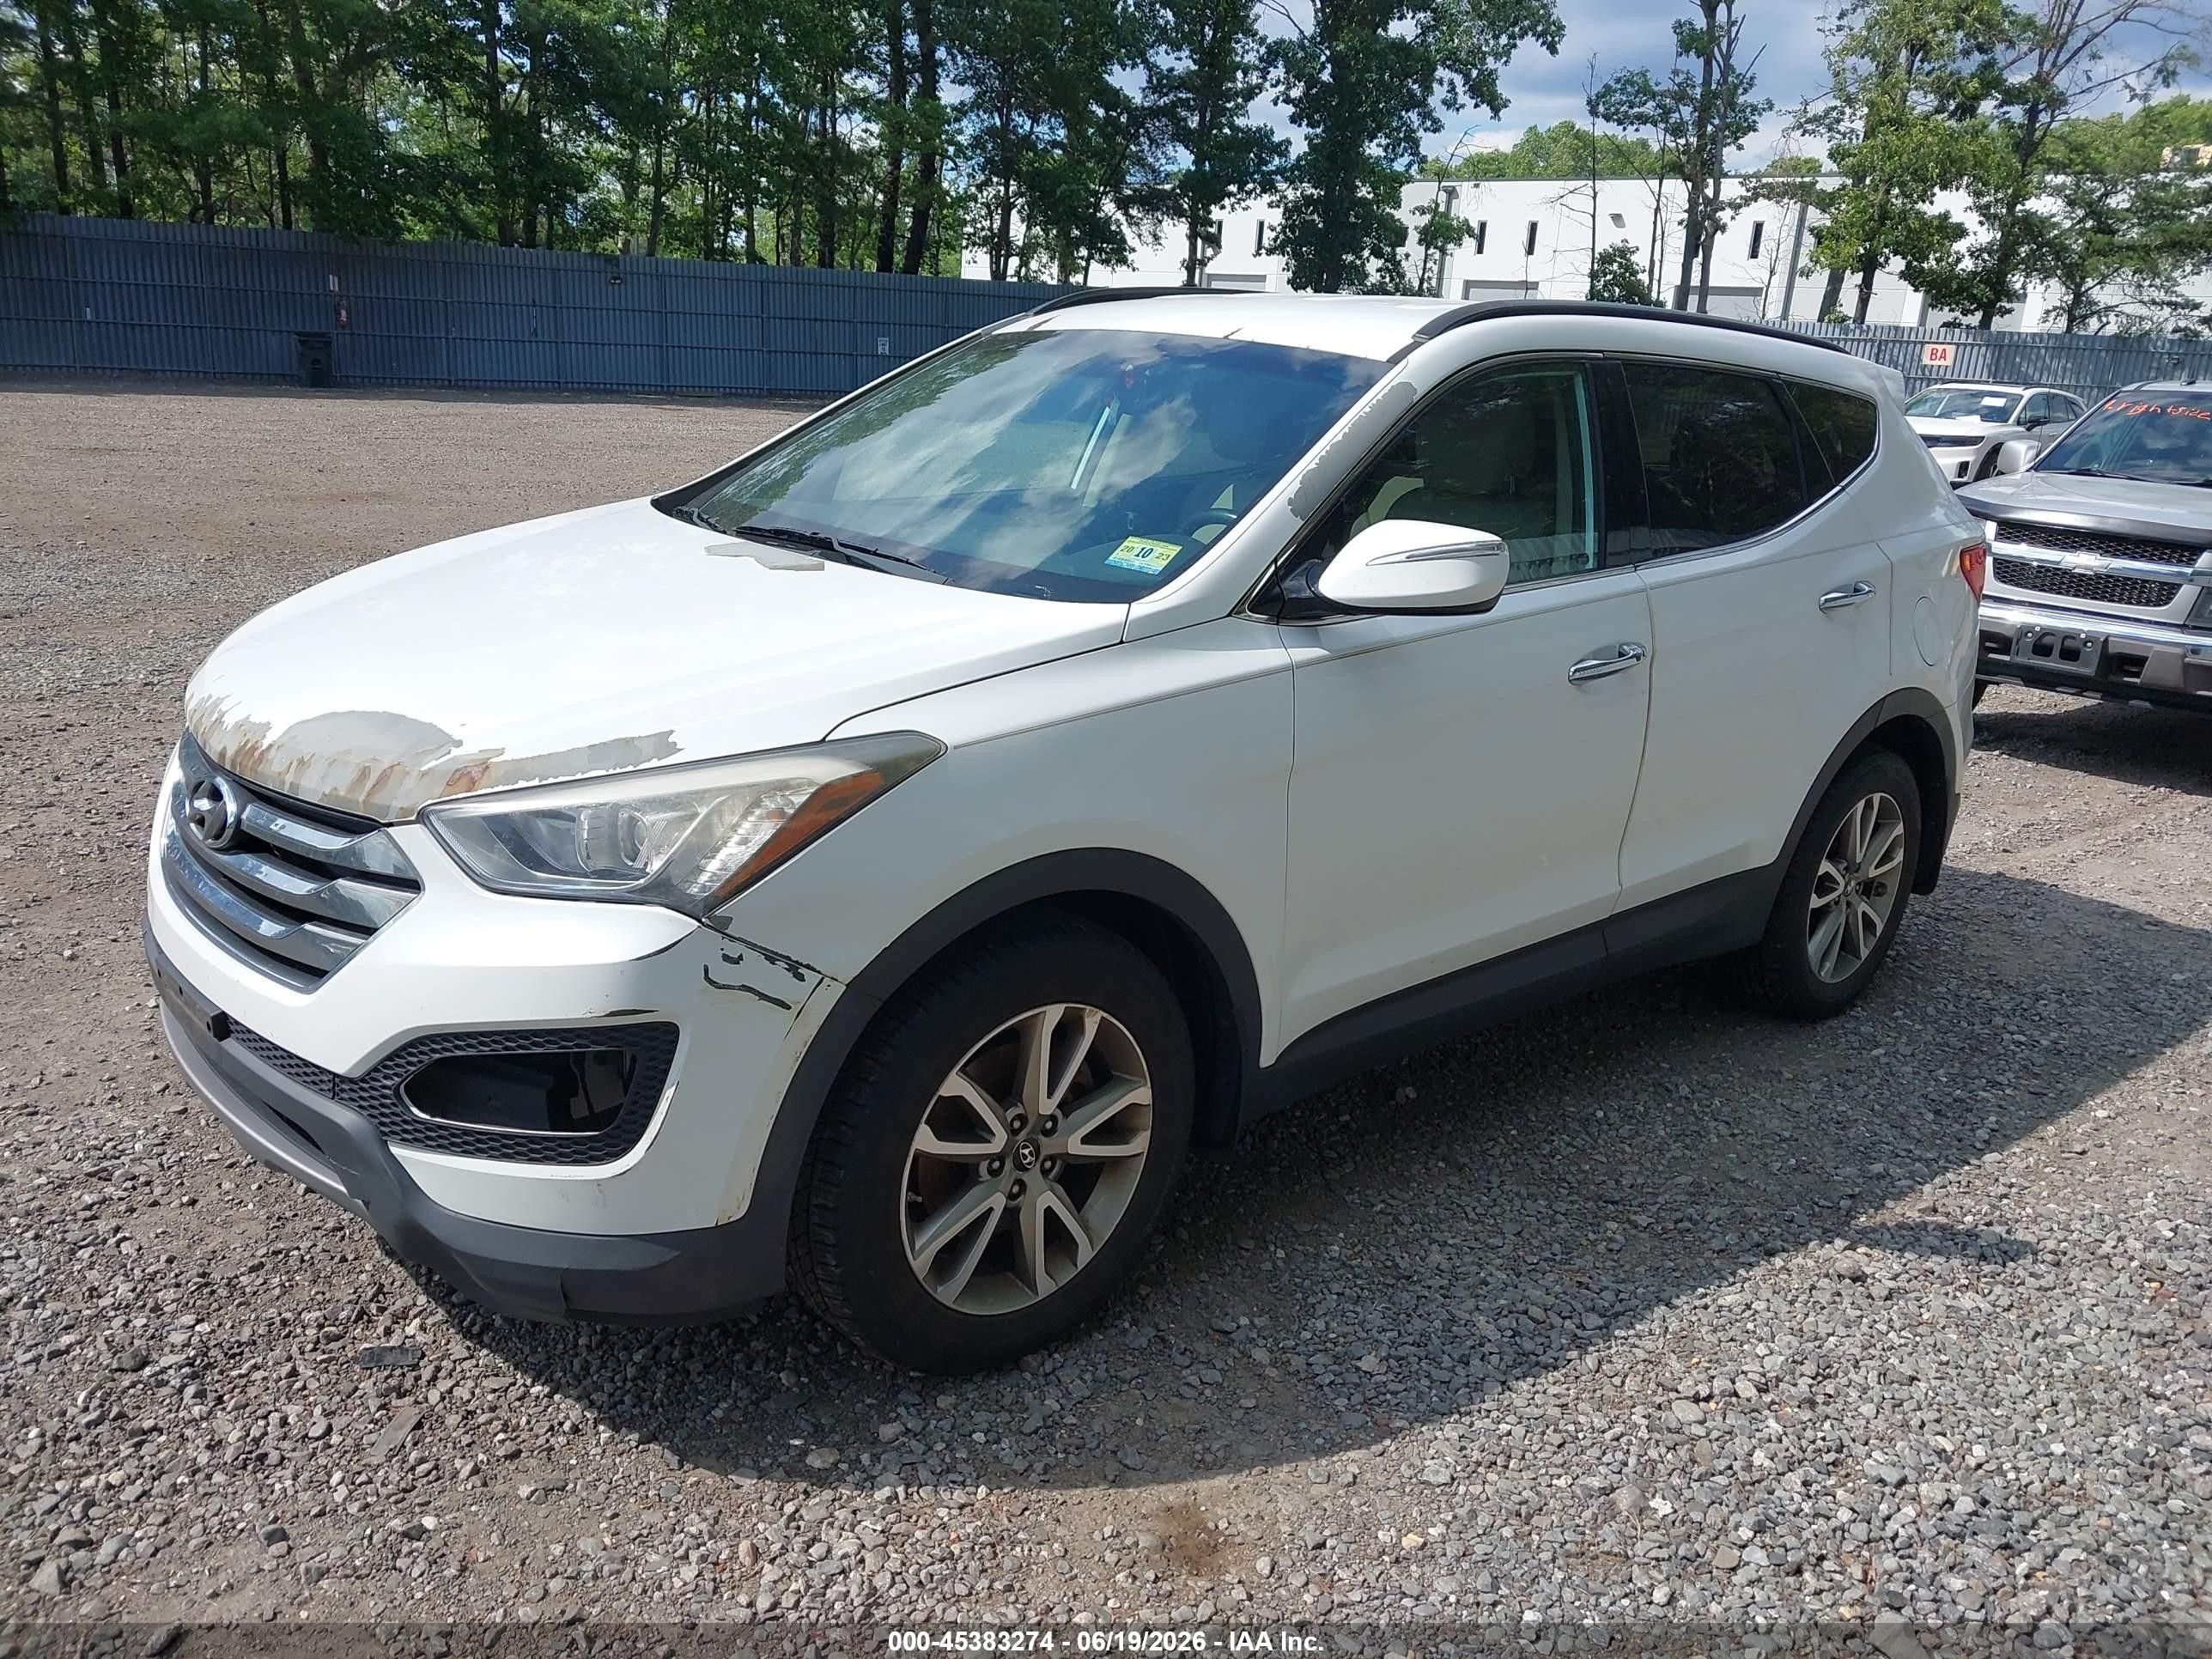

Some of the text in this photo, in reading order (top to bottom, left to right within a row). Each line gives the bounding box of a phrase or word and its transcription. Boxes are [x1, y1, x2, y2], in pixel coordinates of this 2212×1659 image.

[1929, 347, 1947, 362] BA
[1120, 545, 1171, 561] 20 10 23
